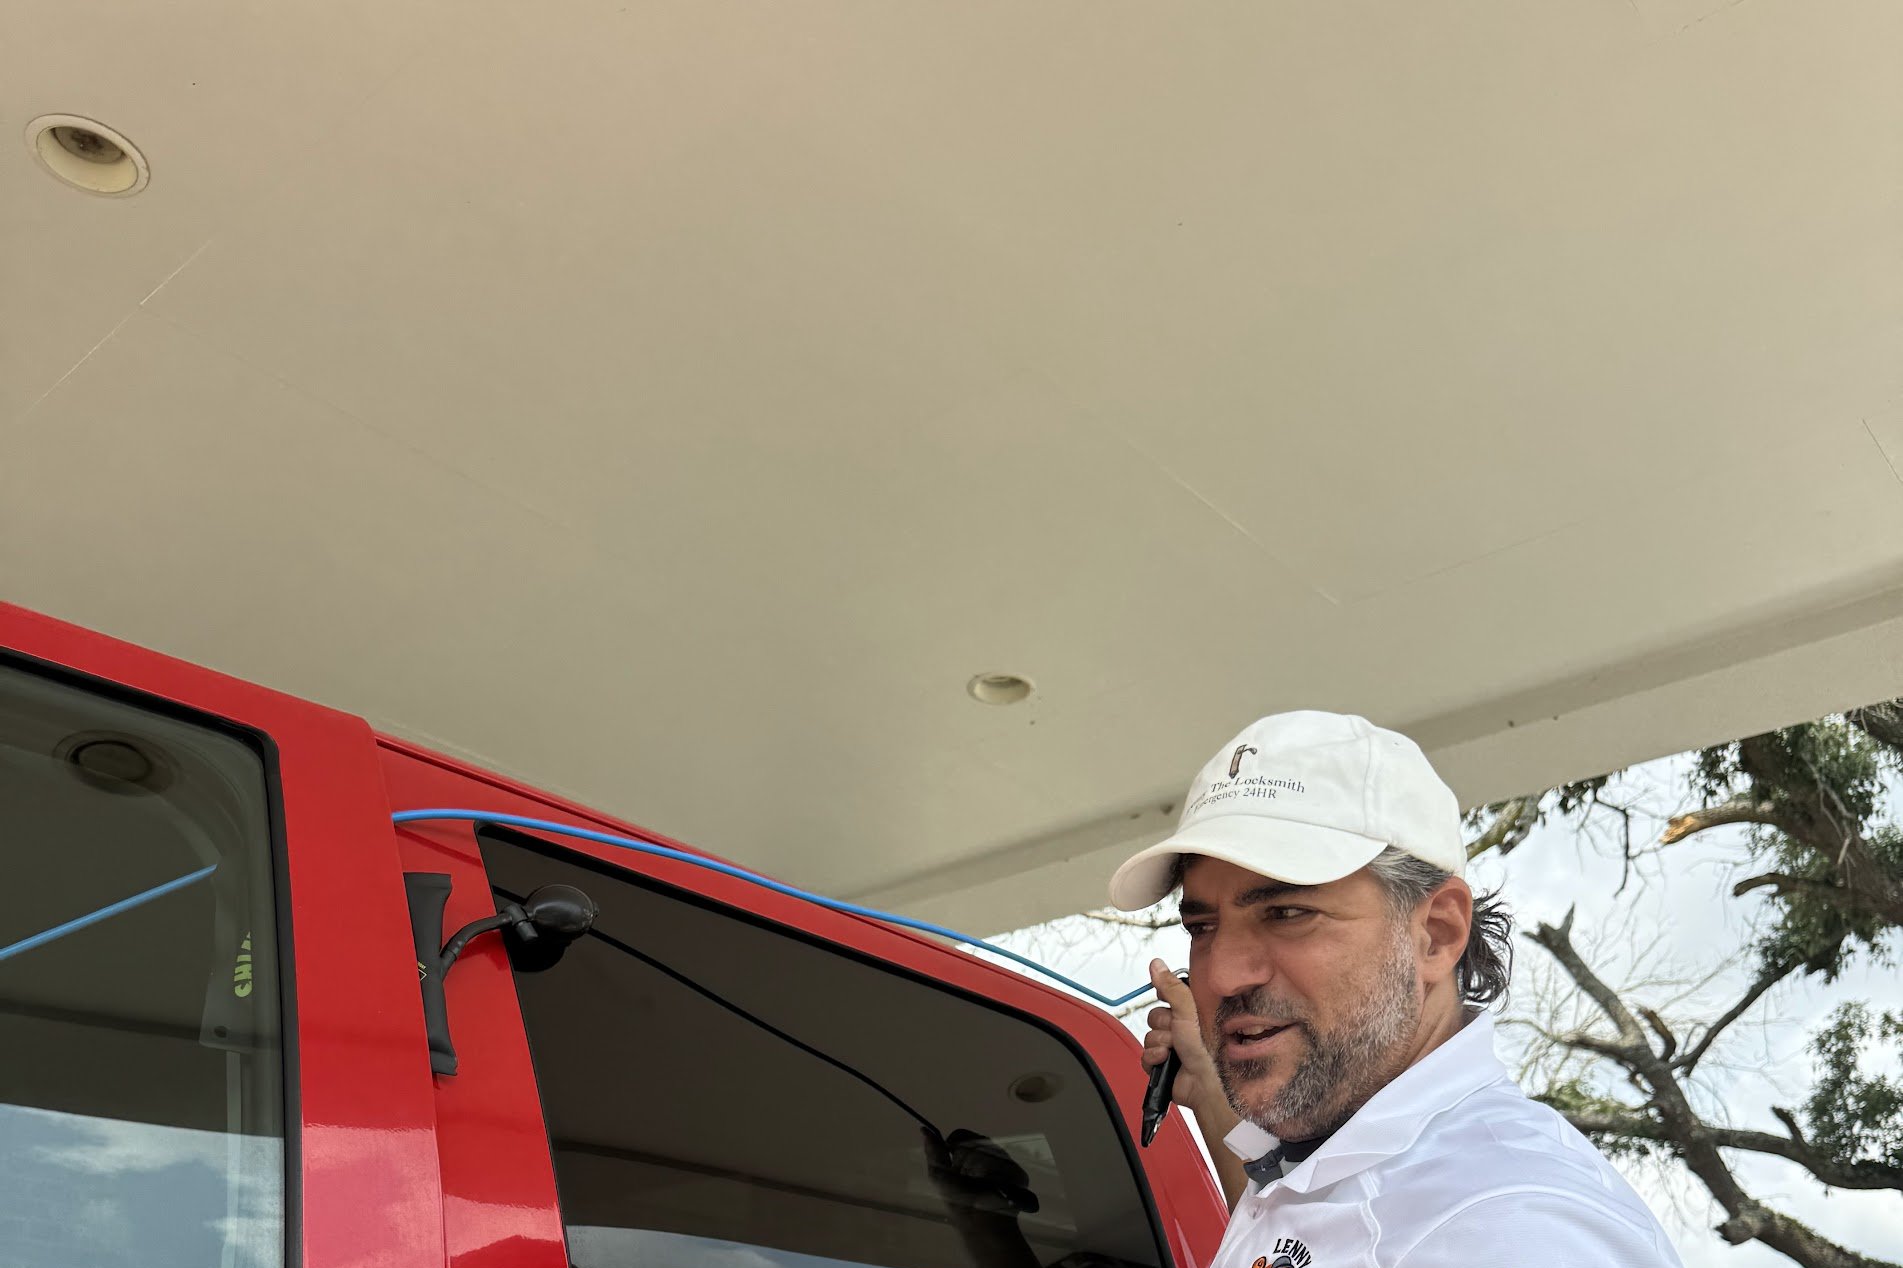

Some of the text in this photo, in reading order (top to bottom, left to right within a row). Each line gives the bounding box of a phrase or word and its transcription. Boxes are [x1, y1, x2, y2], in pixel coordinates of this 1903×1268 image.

[1211, 776, 1305, 793] The Locksmith
[1243, 787, 1277, 799] 24HR
